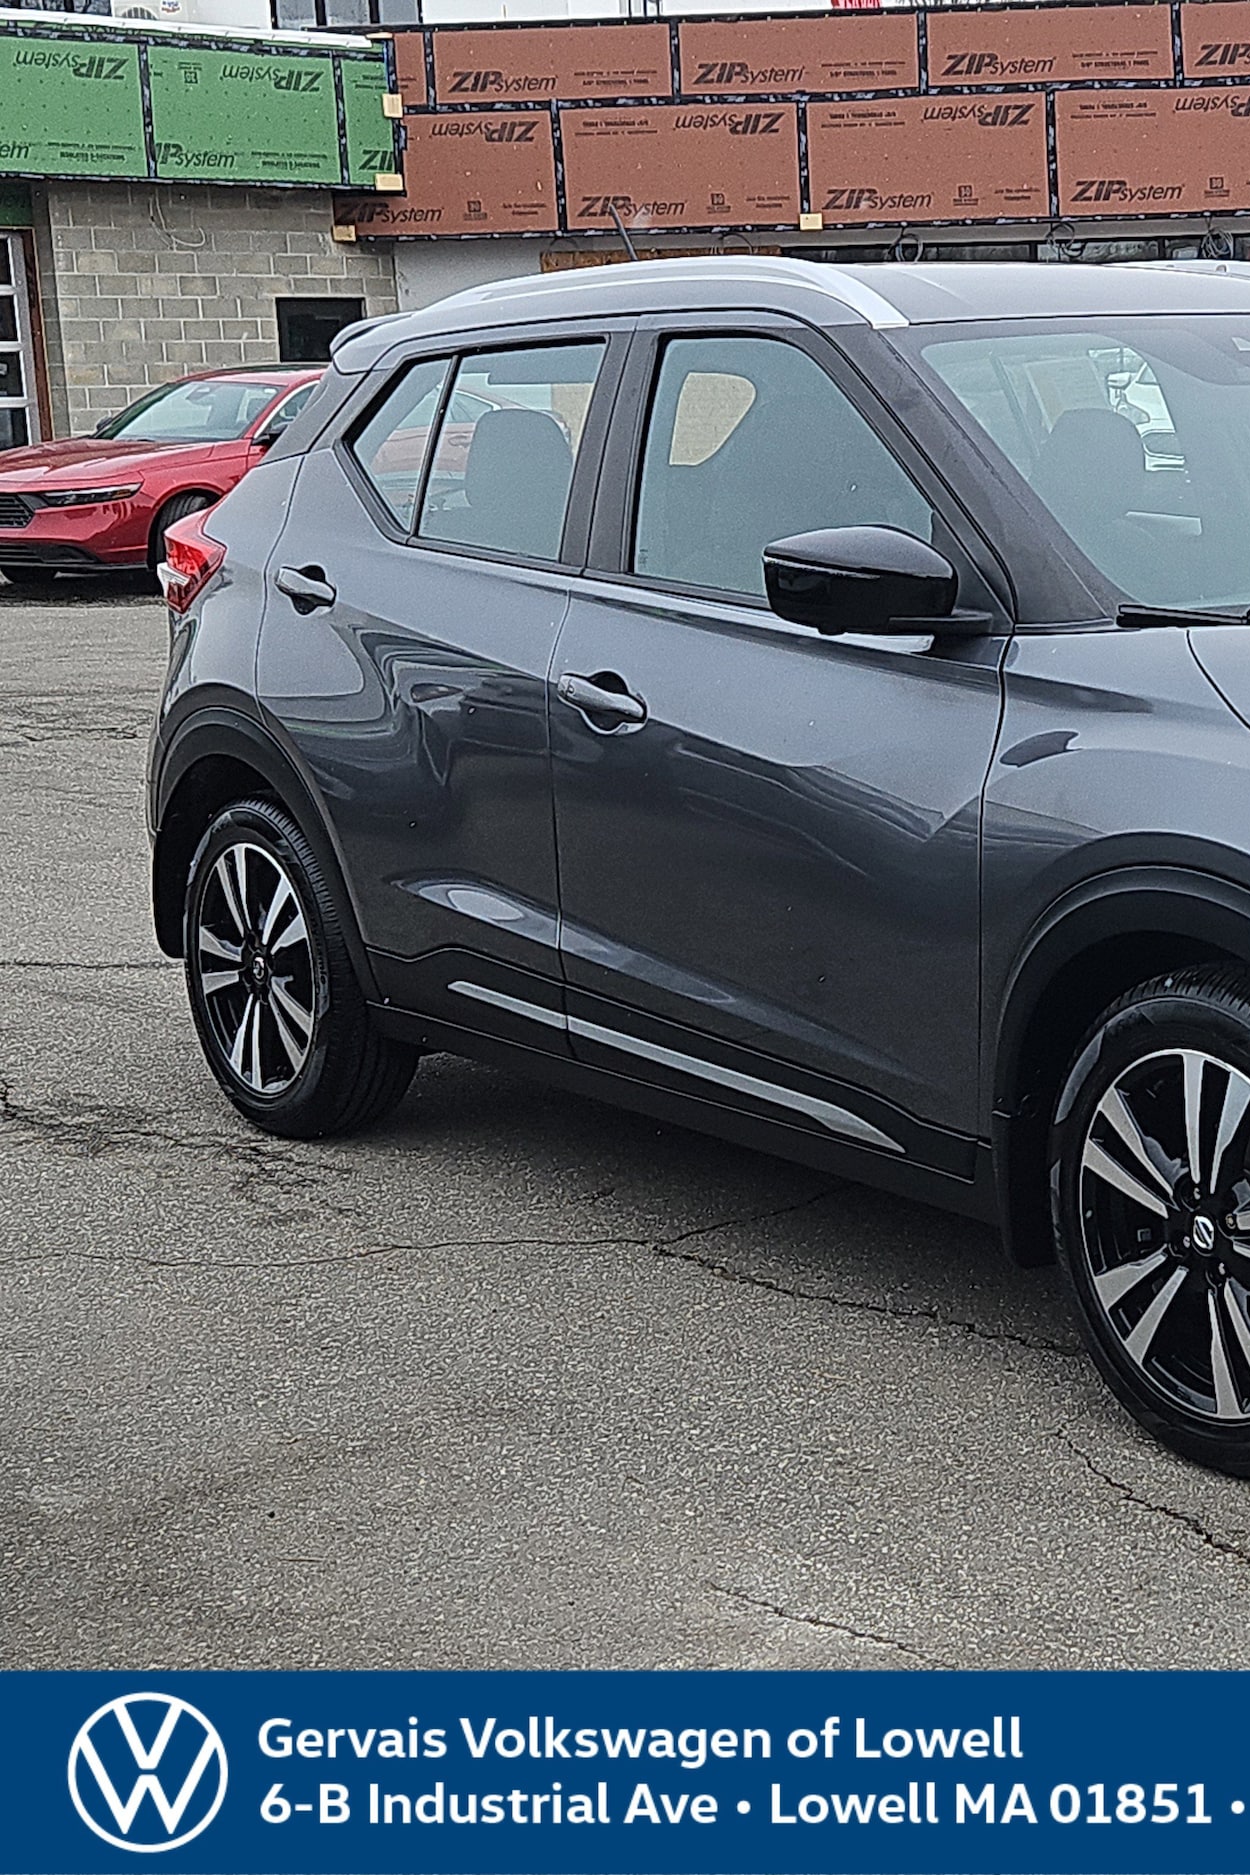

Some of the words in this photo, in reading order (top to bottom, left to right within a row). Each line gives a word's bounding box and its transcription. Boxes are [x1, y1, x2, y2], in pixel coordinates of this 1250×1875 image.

[13, 50, 130, 80] ZIPsystem
[693, 62, 807, 85] ZIPsystem
[941, 52, 1056, 77] ZIPsystem
[220, 64, 325, 93] ZIPsystem
[448, 71, 558, 93] ZIPsystem
[673, 112, 785, 136] ZIPsystem
[920, 103, 1035, 127] ZIPsystem
[429, 121, 541, 143] ZIPsystem
[822, 188, 934, 210] ZIPsystem
[1070, 179, 1185, 202] ZIPsystem
[577, 196, 688, 218] ZIPsystem
